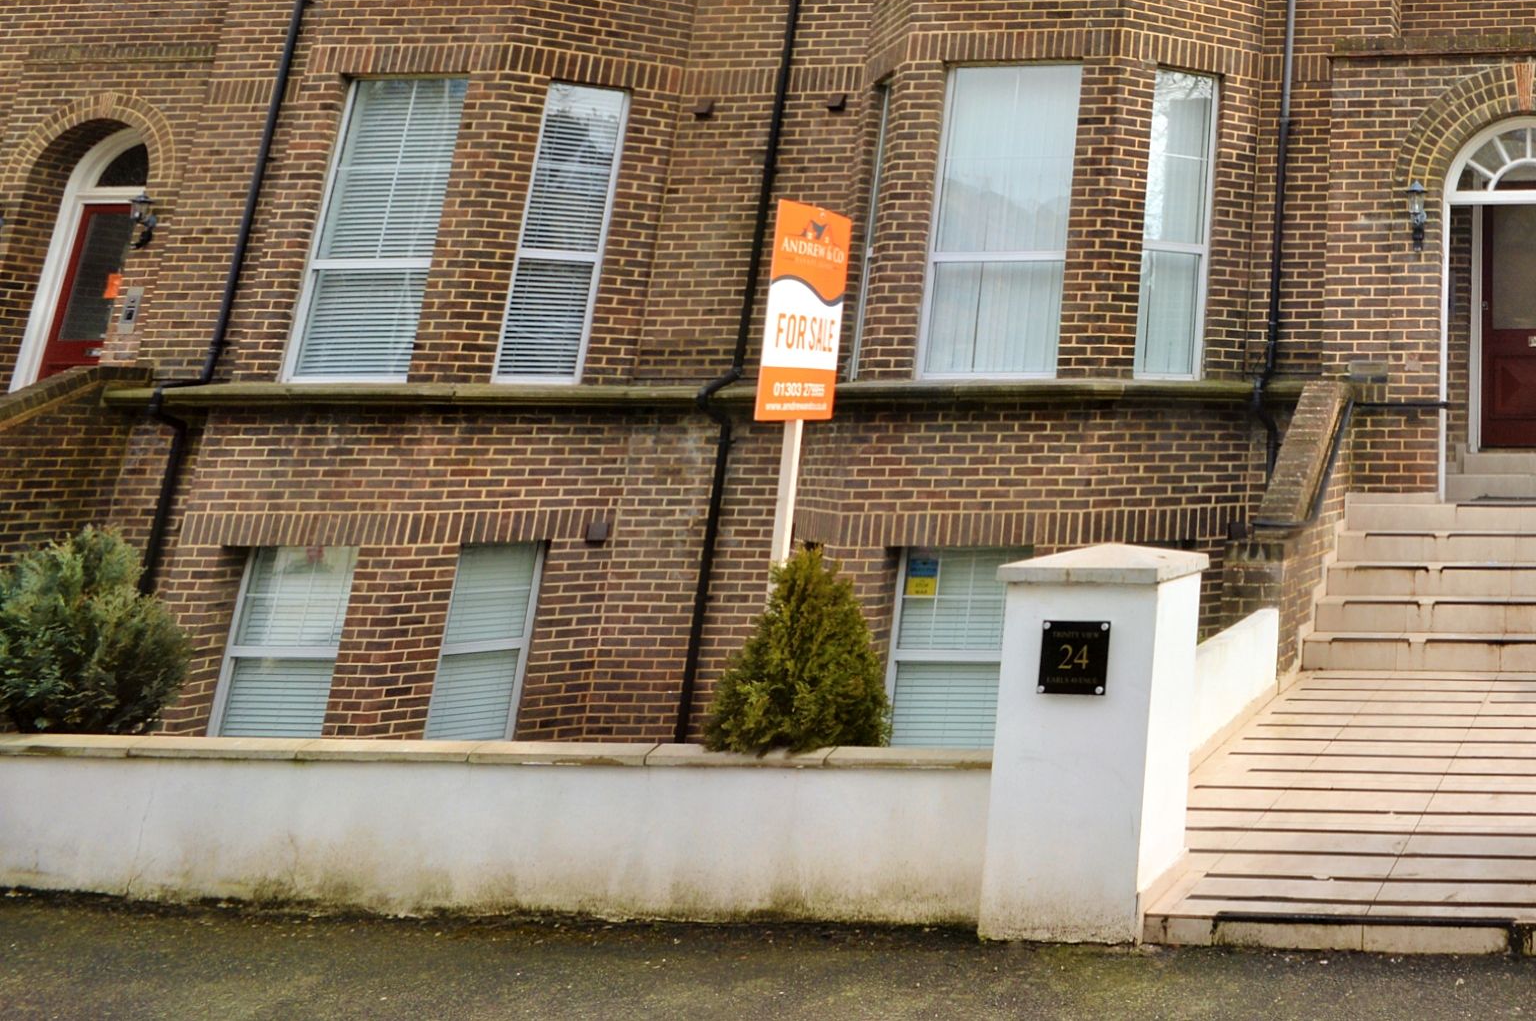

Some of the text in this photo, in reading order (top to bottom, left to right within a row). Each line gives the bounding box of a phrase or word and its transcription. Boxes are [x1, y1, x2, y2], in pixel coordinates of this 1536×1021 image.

[781, 237, 826, 258] ANDREW
[827, 245, 832, 260] &
[775, 313, 836, 352] FOR SALE
[773, 382, 802, 396] 01303
[1058, 644, 1089, 669] 24
